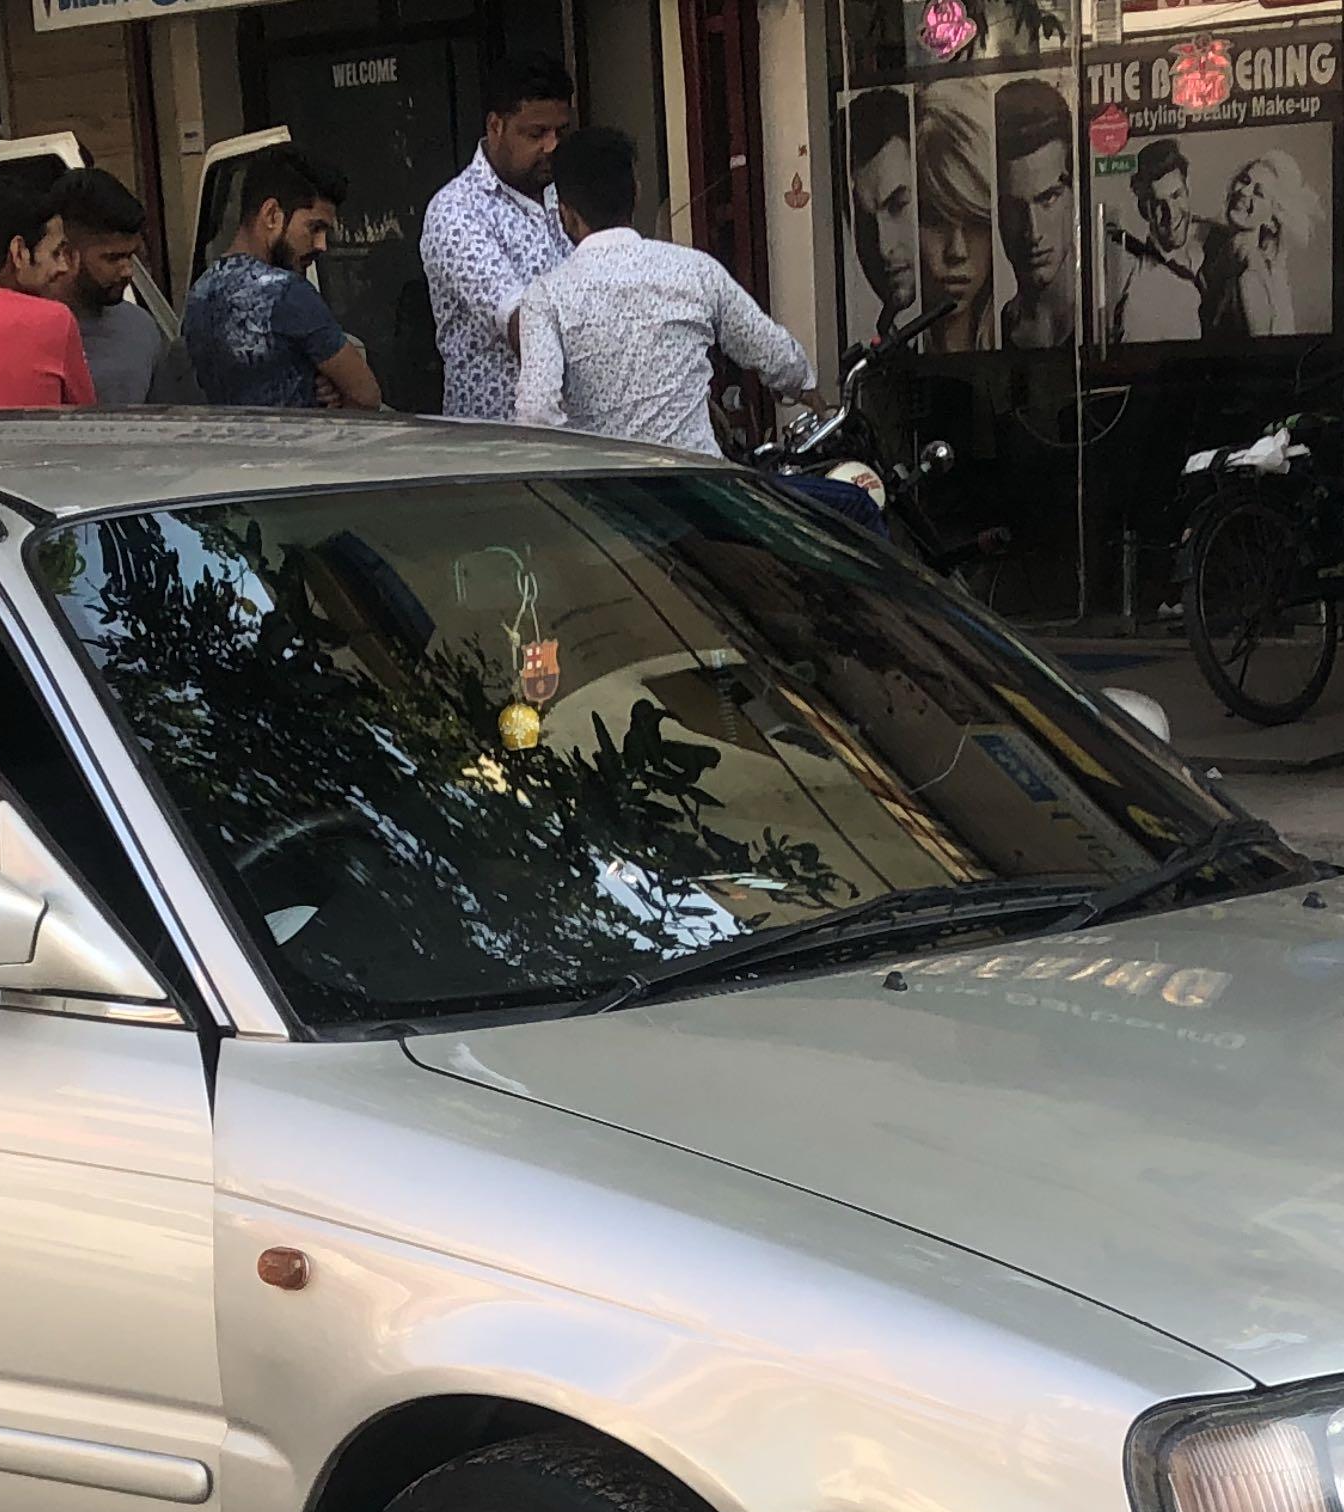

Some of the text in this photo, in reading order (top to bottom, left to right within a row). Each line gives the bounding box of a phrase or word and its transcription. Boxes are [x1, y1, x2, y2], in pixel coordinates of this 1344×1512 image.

[332, 58, 398, 88] WELCOME
[1086, 60, 1141, 104] THE
[1252, 96, 1321, 118] Make-up
